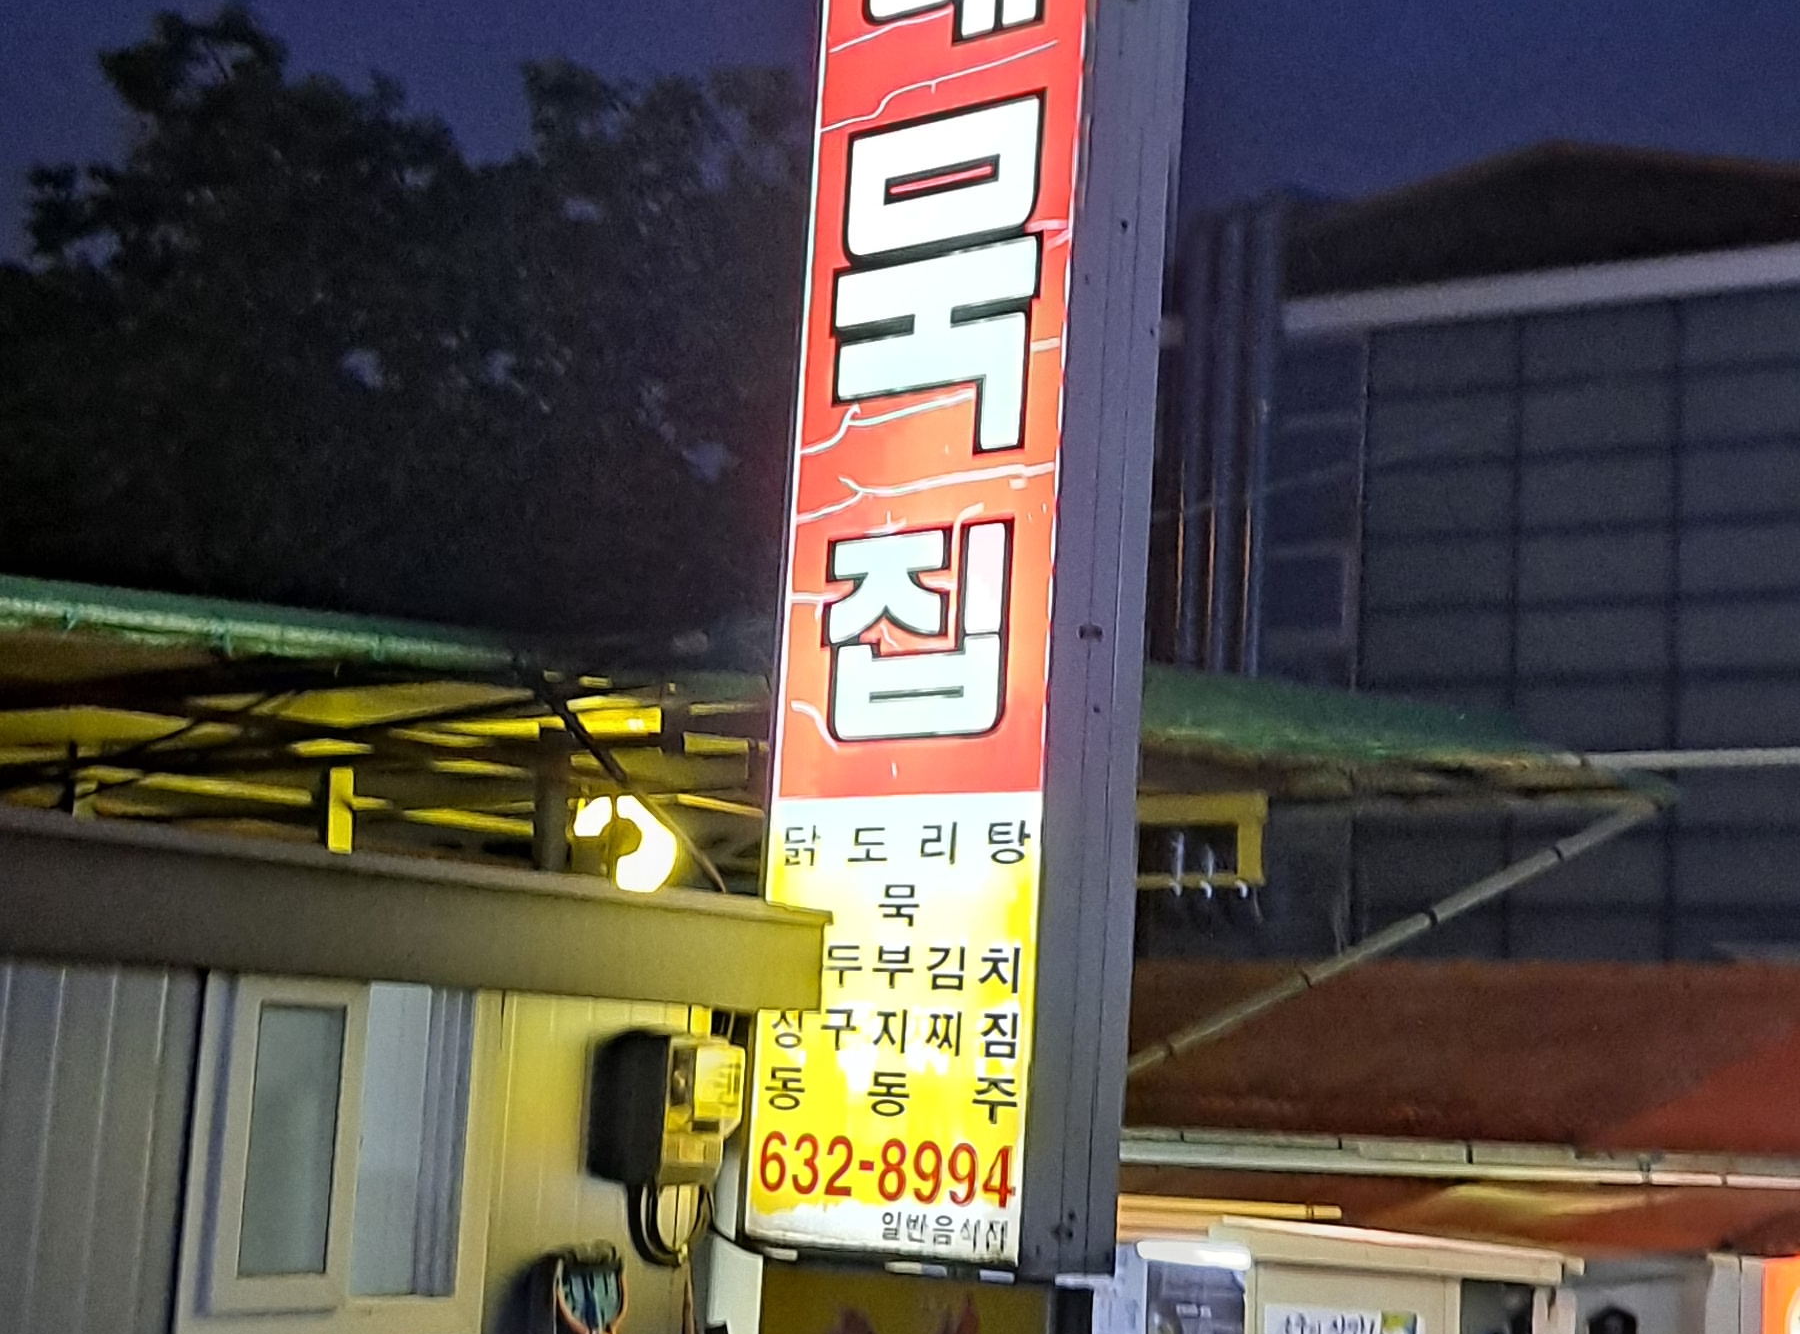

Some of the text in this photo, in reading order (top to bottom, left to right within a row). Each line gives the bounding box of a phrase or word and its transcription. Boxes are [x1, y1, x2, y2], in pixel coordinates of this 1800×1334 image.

[784, 819, 1031, 867] 닭도리탕
[878, 884, 920, 927] 묵
[824, 944, 1022, 994] 두부김치
[765, 1066, 1018, 1124] 동동주
[759, 1130, 1016, 1209] 632-8994
